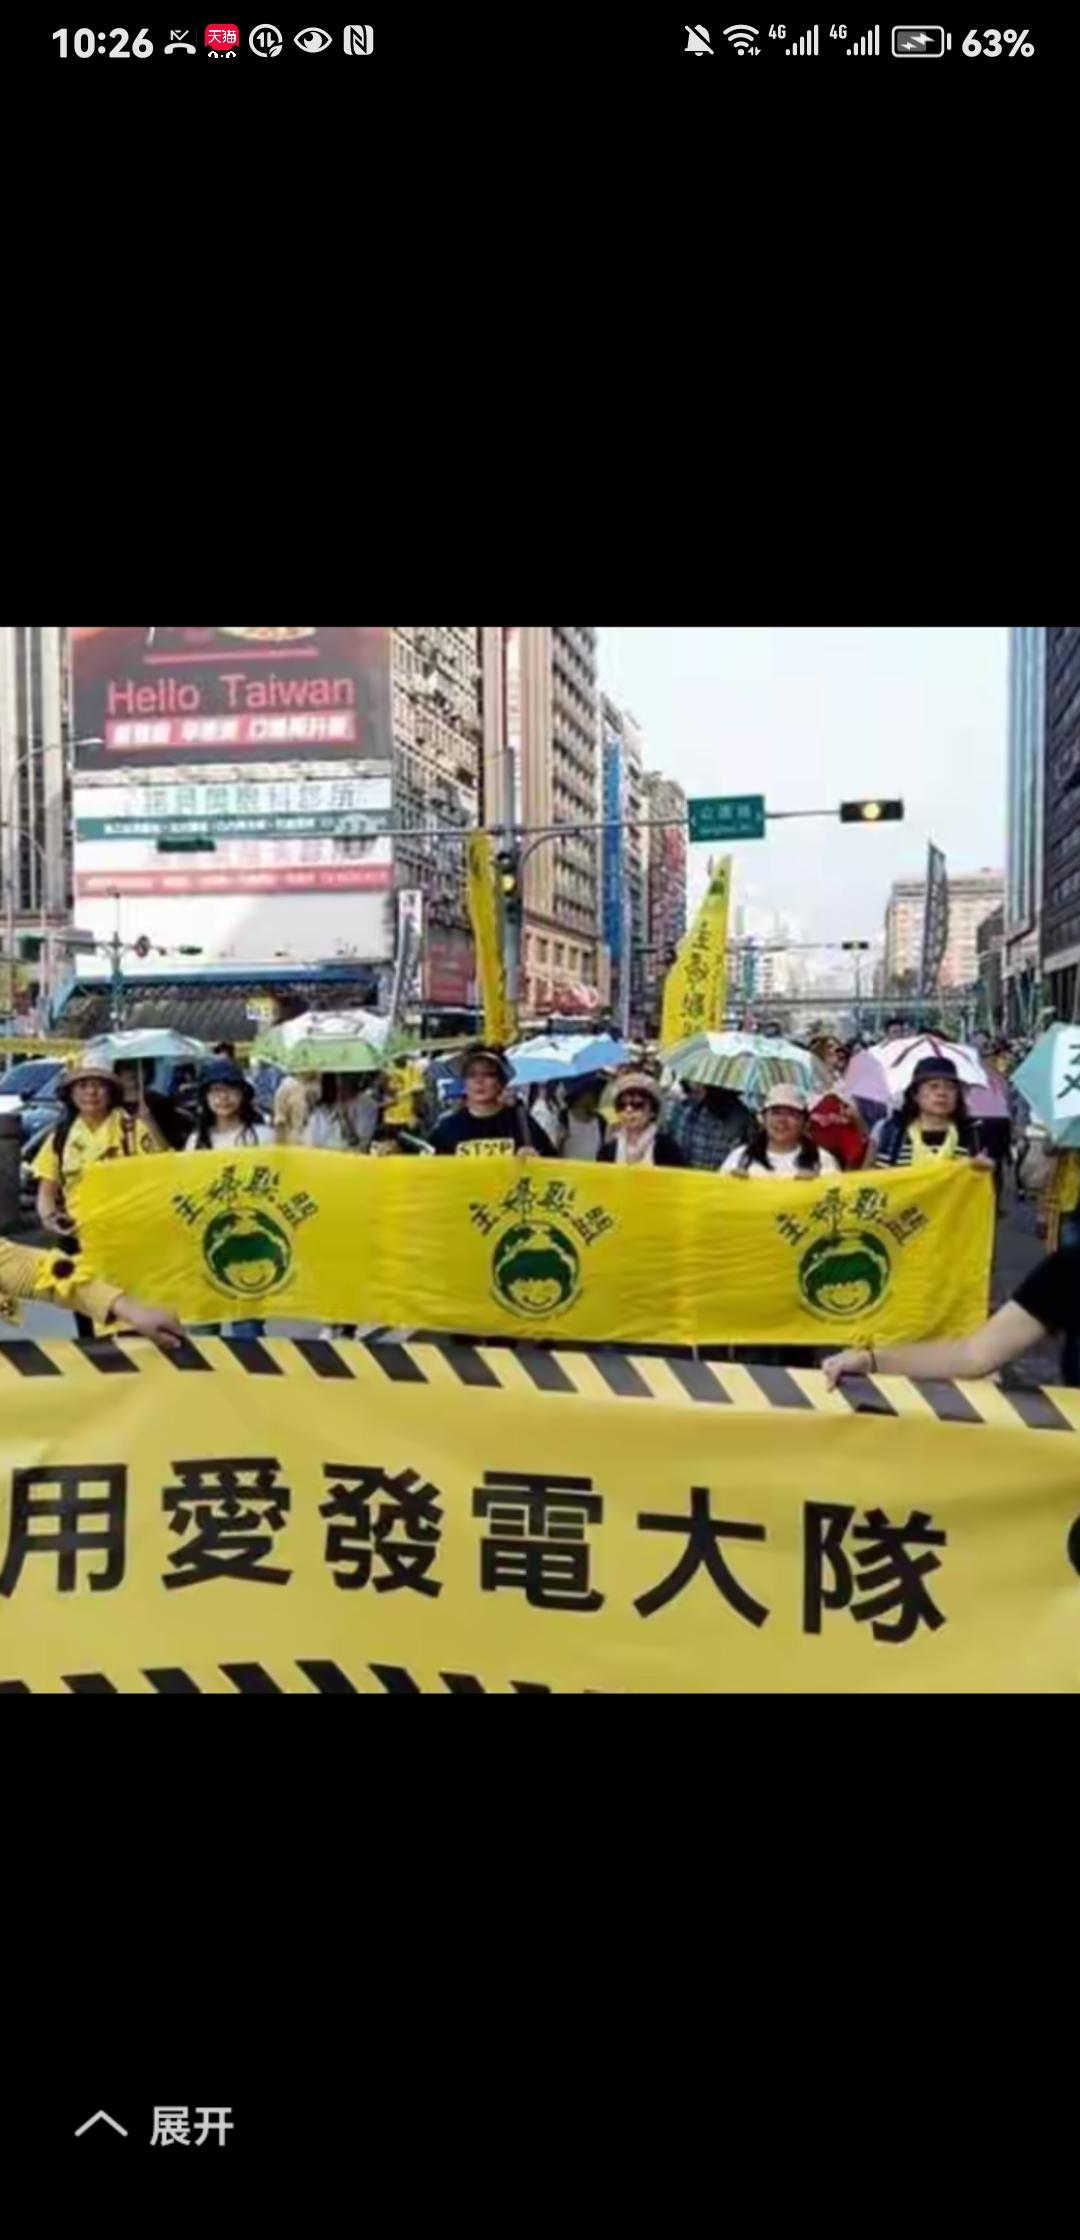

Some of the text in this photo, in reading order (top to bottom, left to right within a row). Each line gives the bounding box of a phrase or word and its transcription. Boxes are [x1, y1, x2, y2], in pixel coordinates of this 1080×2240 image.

[107, 673, 356, 715] Hello Taiwan
[172, 1164, 318, 1229] 主婦聯盟
[469, 1176, 614, 1246] 主婦聯盟
[776, 1186, 929, 1245] 主婦聯盟
[0, 1457, 947, 1644] 用愛發電大隊
